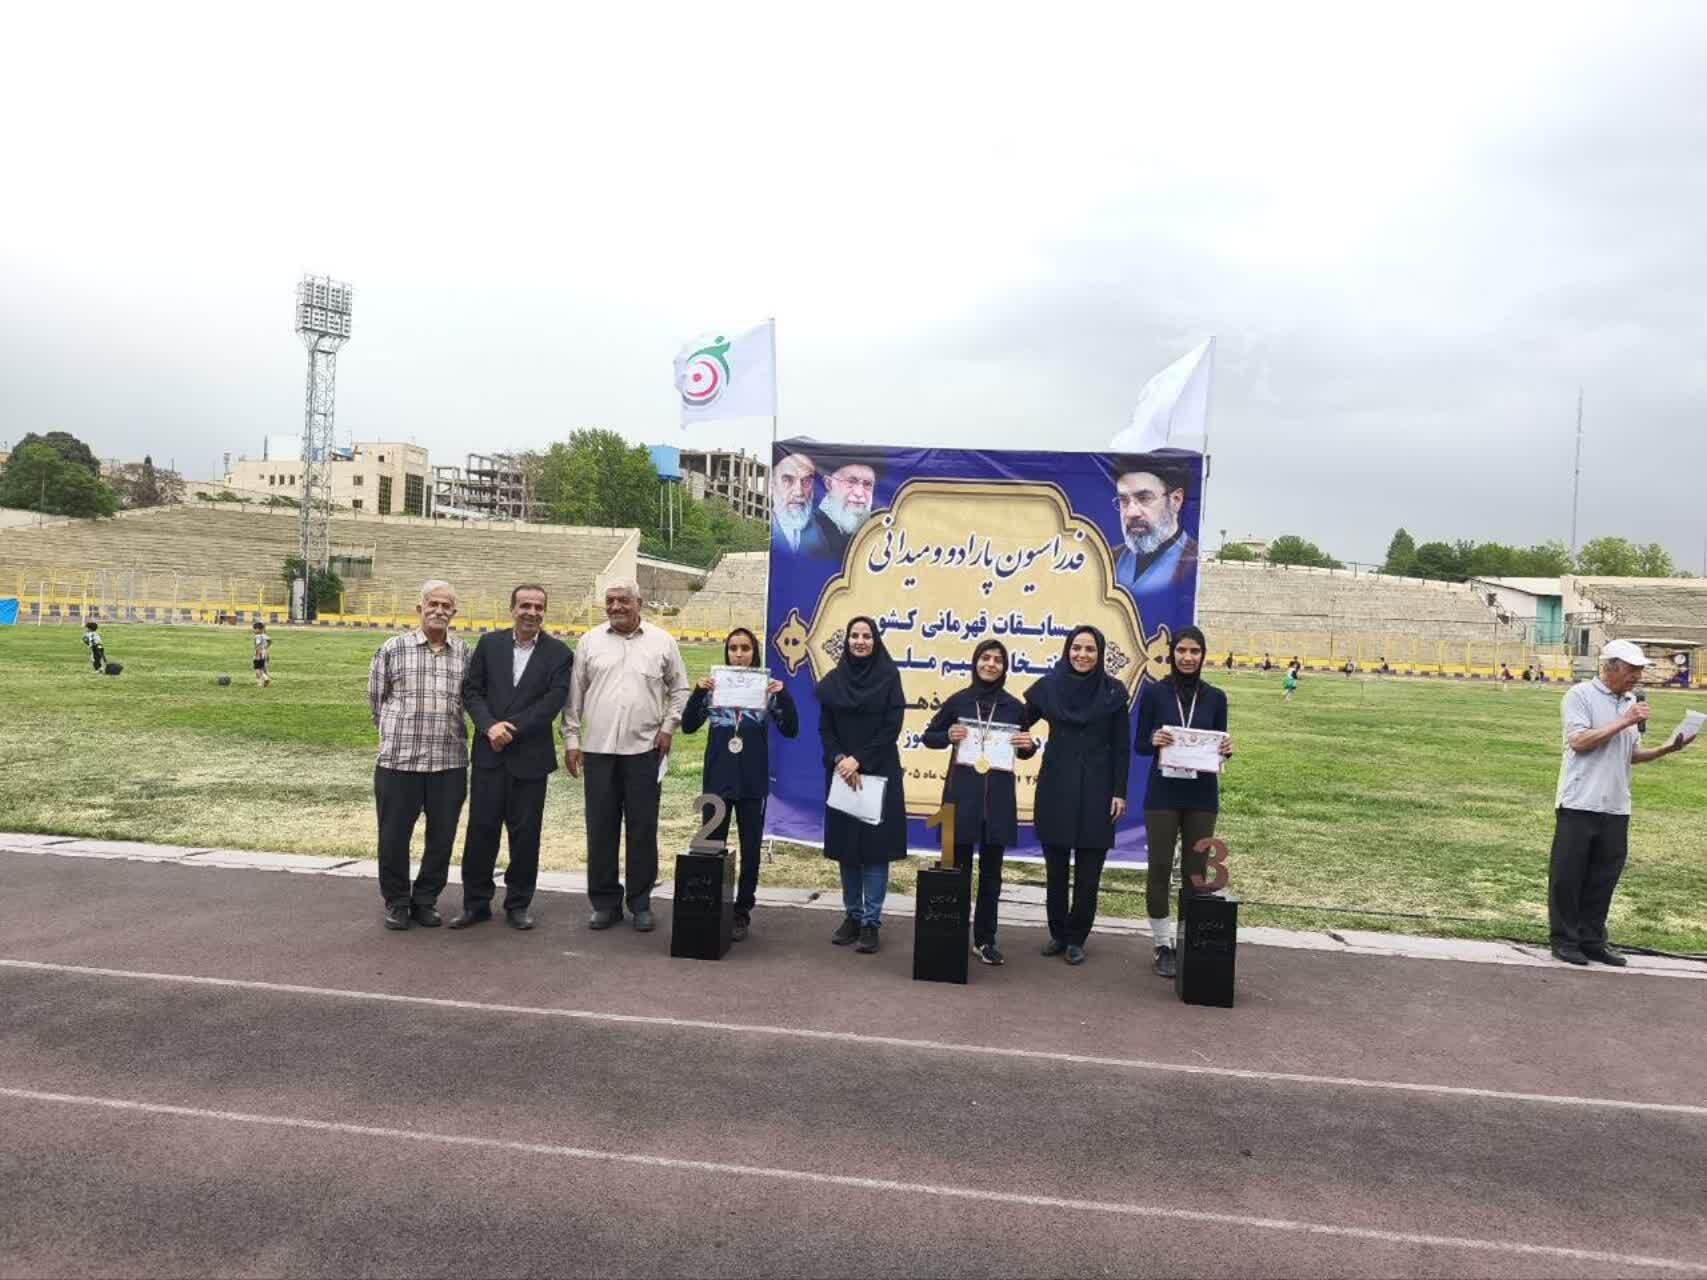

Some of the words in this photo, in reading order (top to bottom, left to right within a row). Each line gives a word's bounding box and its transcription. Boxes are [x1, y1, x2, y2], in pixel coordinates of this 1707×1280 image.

[995, 531, 1085, 593] فدراسیون
[879, 608, 918, 637] کشو
[921, 608, 988, 640] قهرمانی
[991, 612, 1074, 642] سابقات
[895, 648, 936, 669] مل
[689, 794, 726, 848] 2
[927, 803, 955, 867] 1
[1191, 837, 1228, 891] 3
